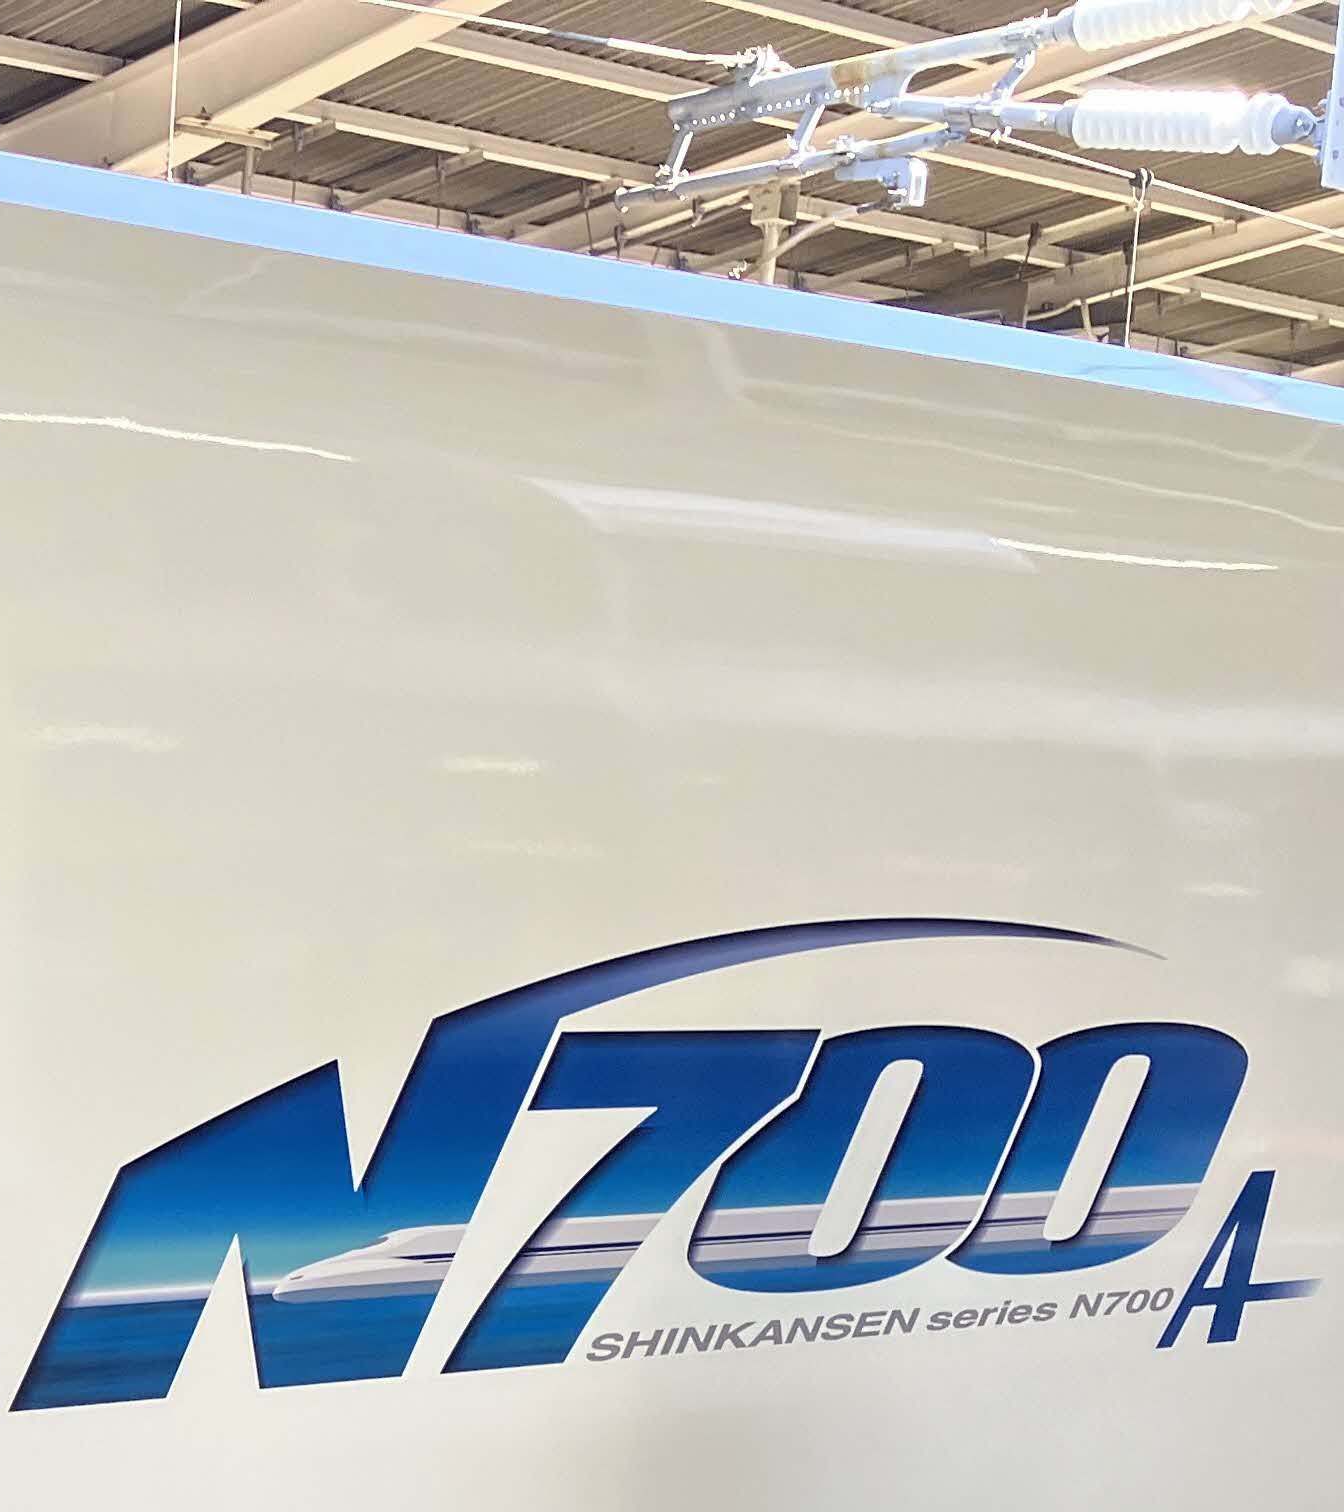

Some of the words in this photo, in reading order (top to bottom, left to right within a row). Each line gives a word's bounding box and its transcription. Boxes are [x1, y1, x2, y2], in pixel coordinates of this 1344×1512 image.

[10, 918, 1249, 1411] N700
[586, 1291, 921, 1362] SHINKANSEN
[926, 1299, 1057, 1331] series
[1069, 1288, 1174, 1319] N700
